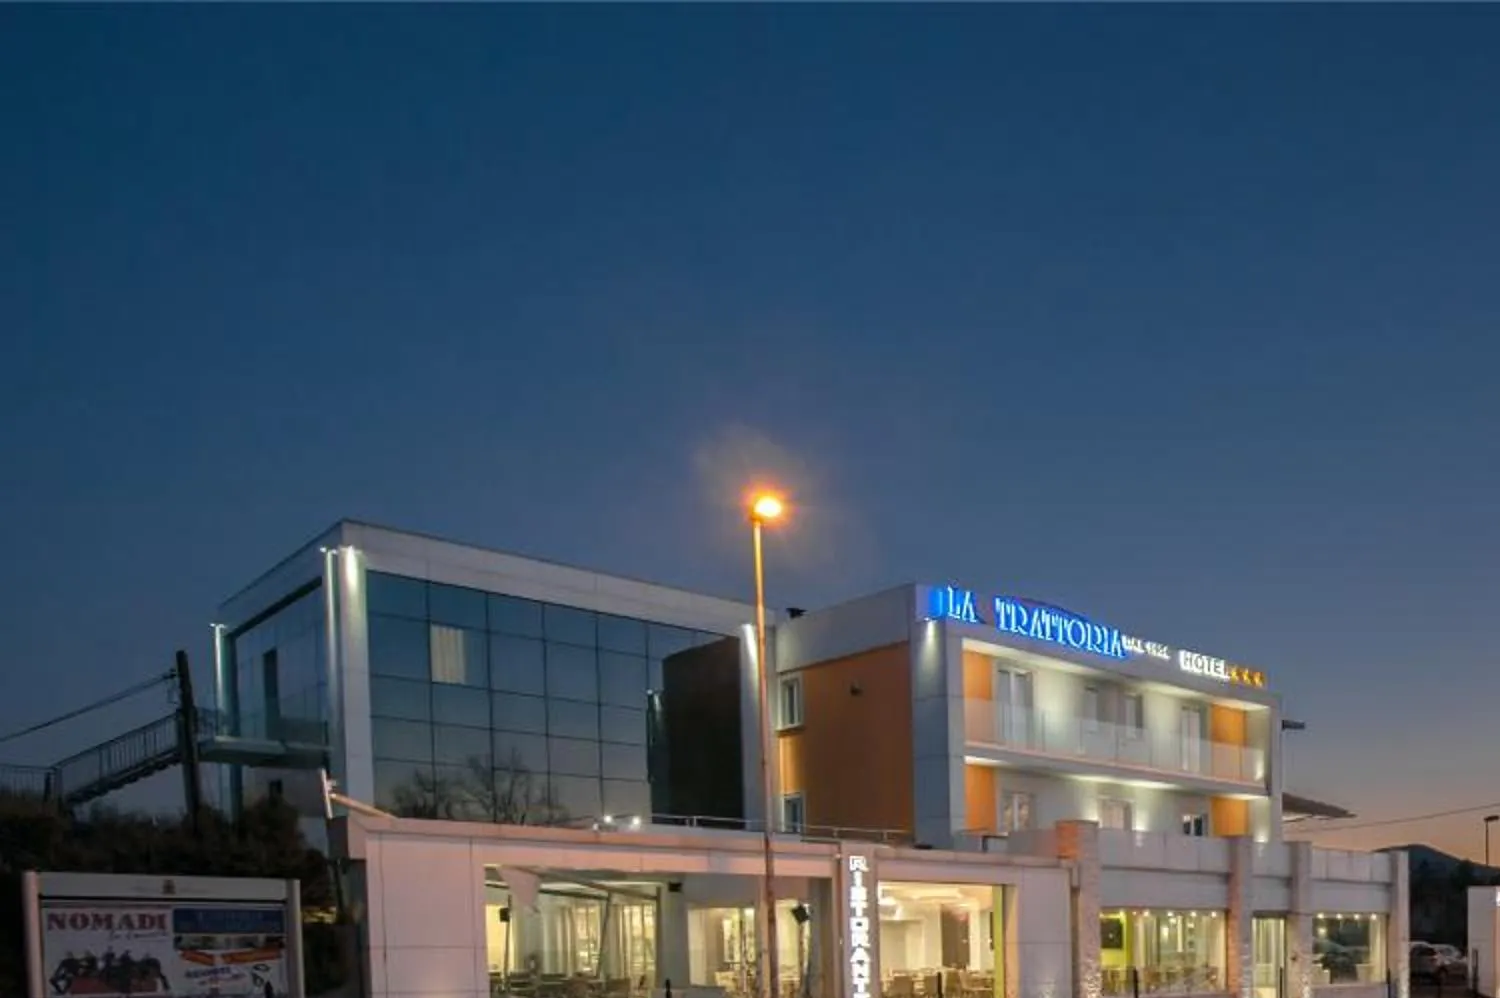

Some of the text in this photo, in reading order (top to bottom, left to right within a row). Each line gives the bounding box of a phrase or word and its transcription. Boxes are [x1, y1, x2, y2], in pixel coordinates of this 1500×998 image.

[946, 586, 977, 623] LA
[994, 597, 1125, 657] TRATTORIA
[1179, 648, 1230, 680] HOTEL
[47, 912, 167, 932] NOMADI
